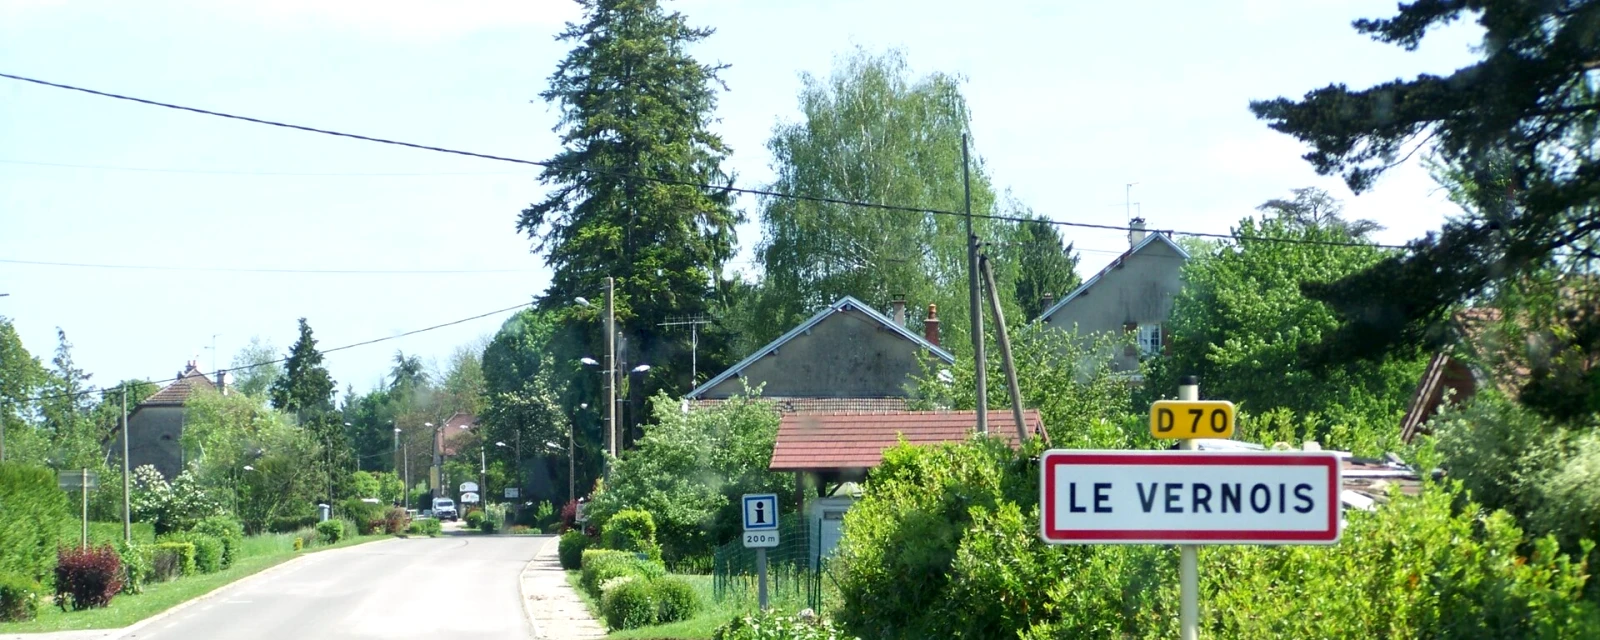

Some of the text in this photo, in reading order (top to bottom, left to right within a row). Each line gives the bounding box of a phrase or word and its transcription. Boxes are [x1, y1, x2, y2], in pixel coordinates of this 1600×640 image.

[1157, 407, 1228, 433] D 70
[1069, 482, 1315, 514] LE VERNOIS
[747, 535, 766, 543] 200
